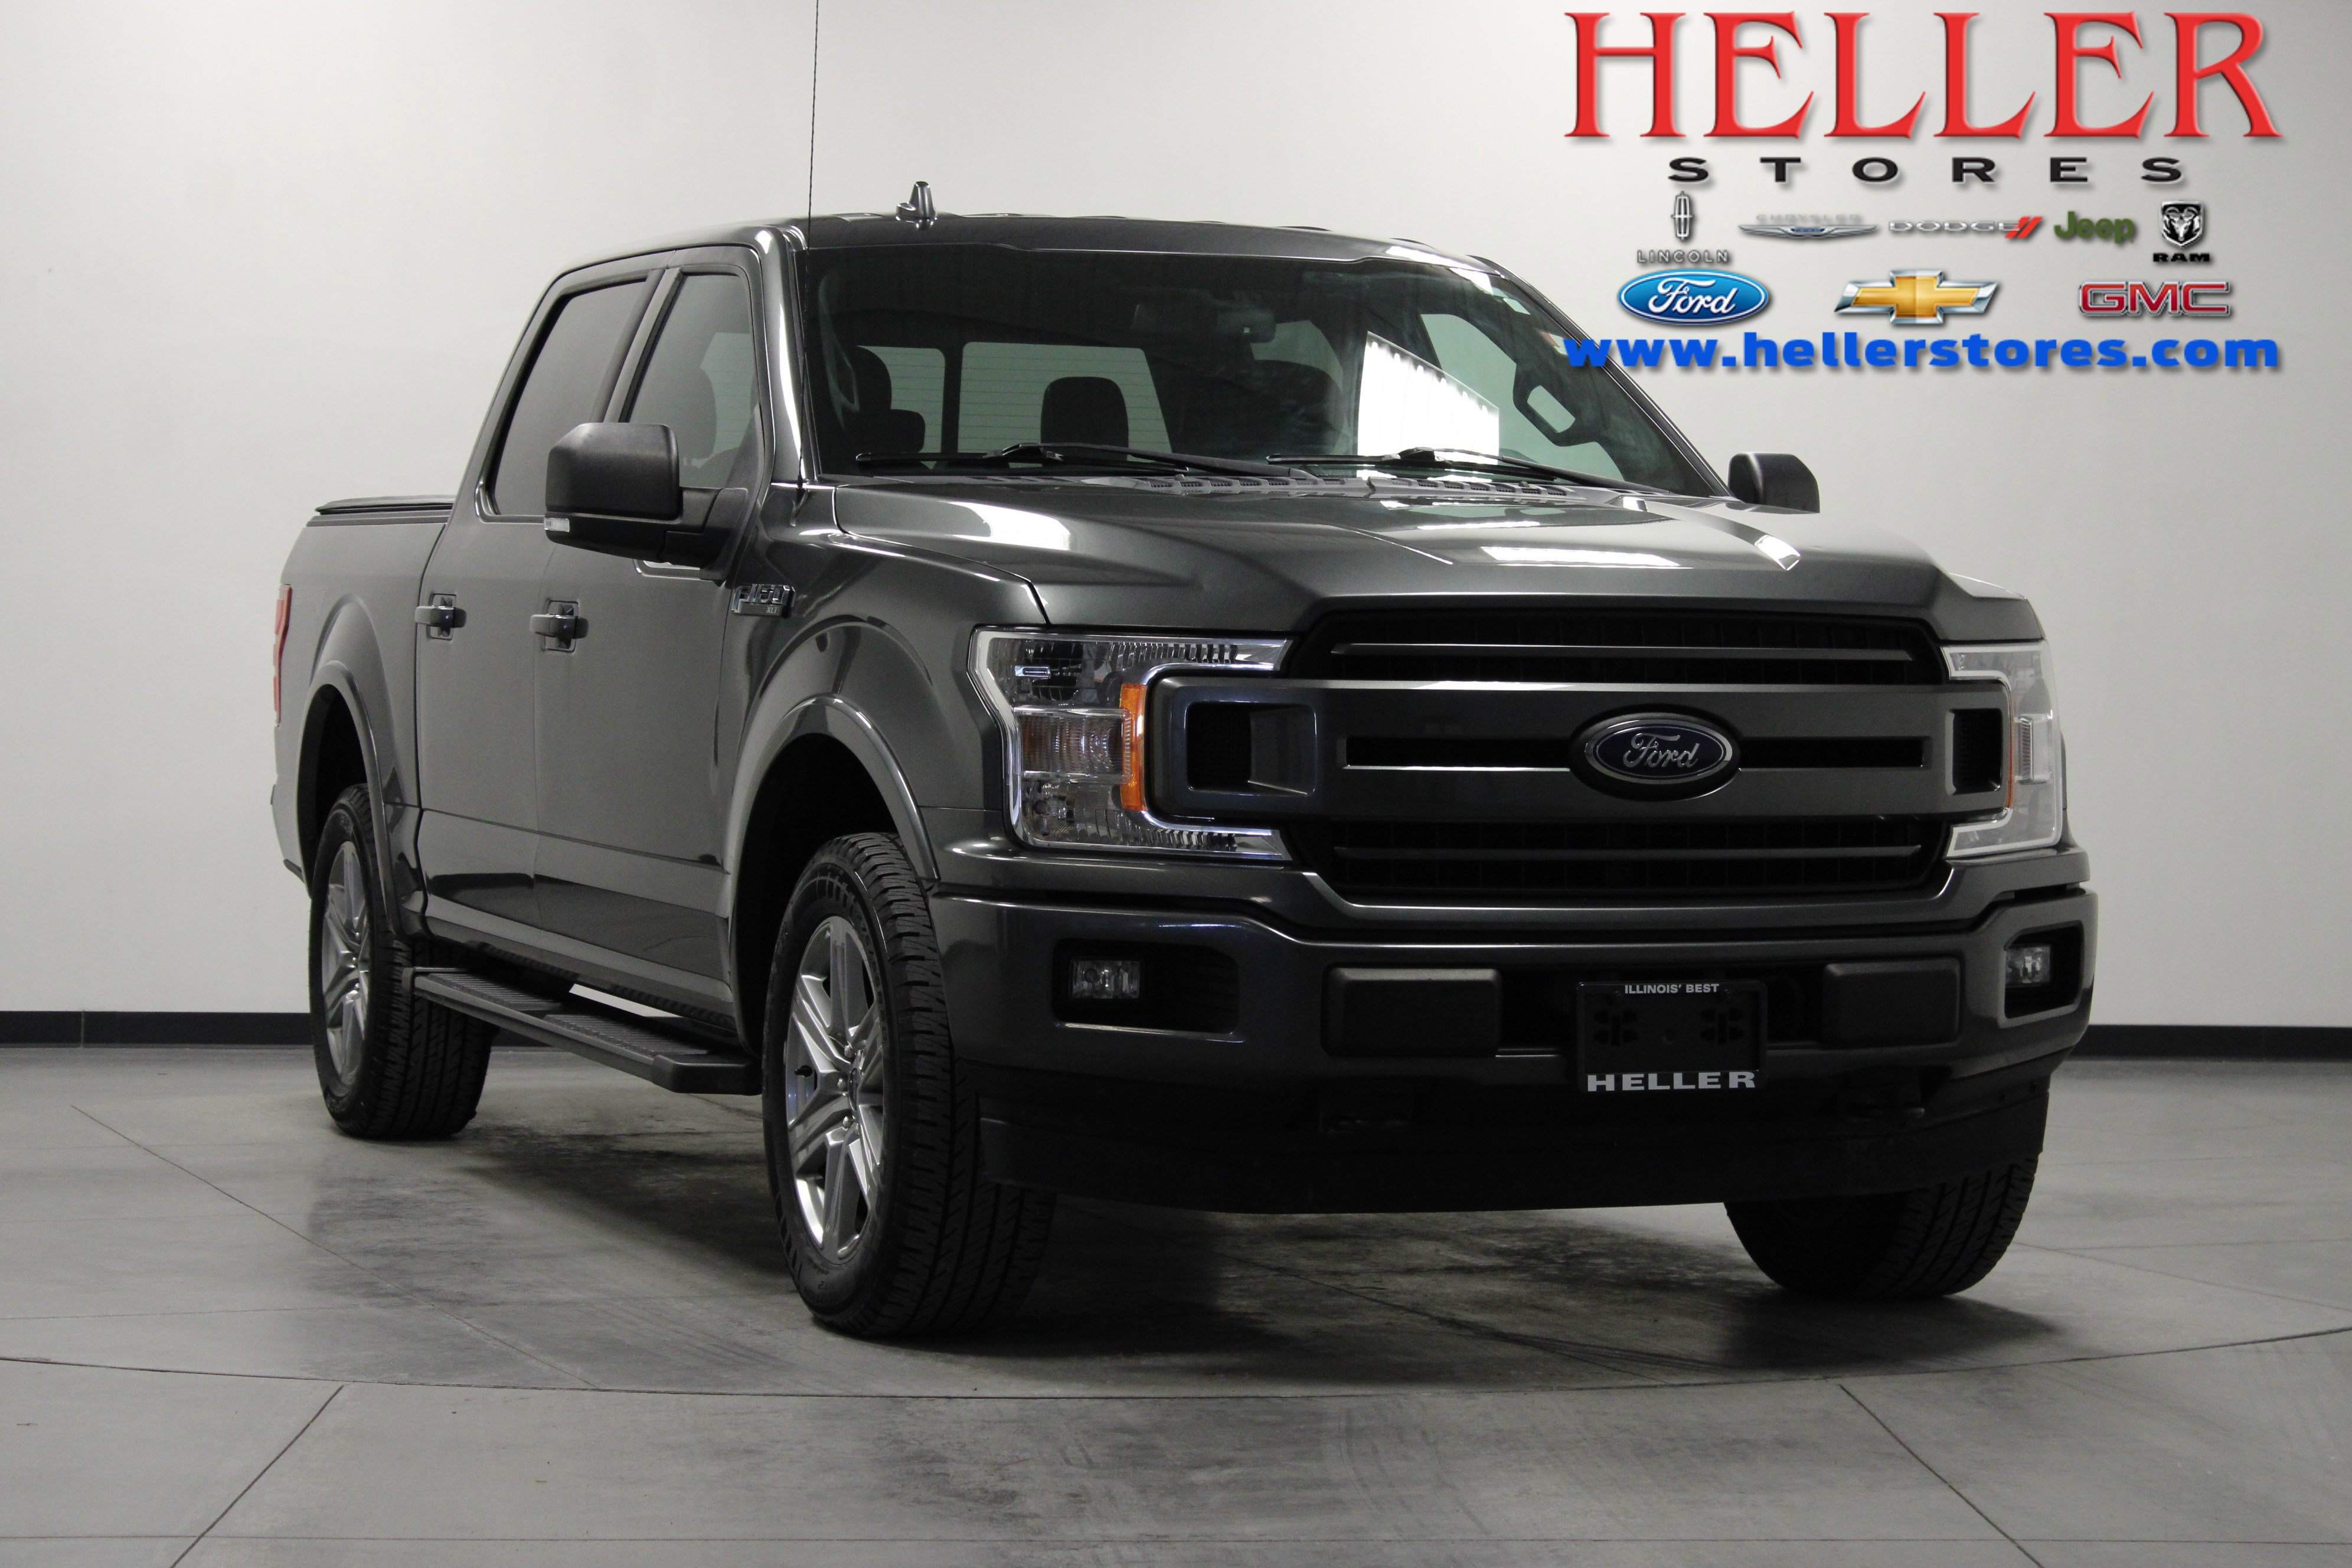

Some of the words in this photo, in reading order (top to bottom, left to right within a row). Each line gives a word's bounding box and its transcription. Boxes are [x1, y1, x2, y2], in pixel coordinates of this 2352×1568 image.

[1623, 732, 1700, 768] Ford
[1625, 984, 1682, 994] ILLINOIS'
[1686, 984, 1720, 993] BEST
[1587, 1072, 1755, 1092] HELLER
